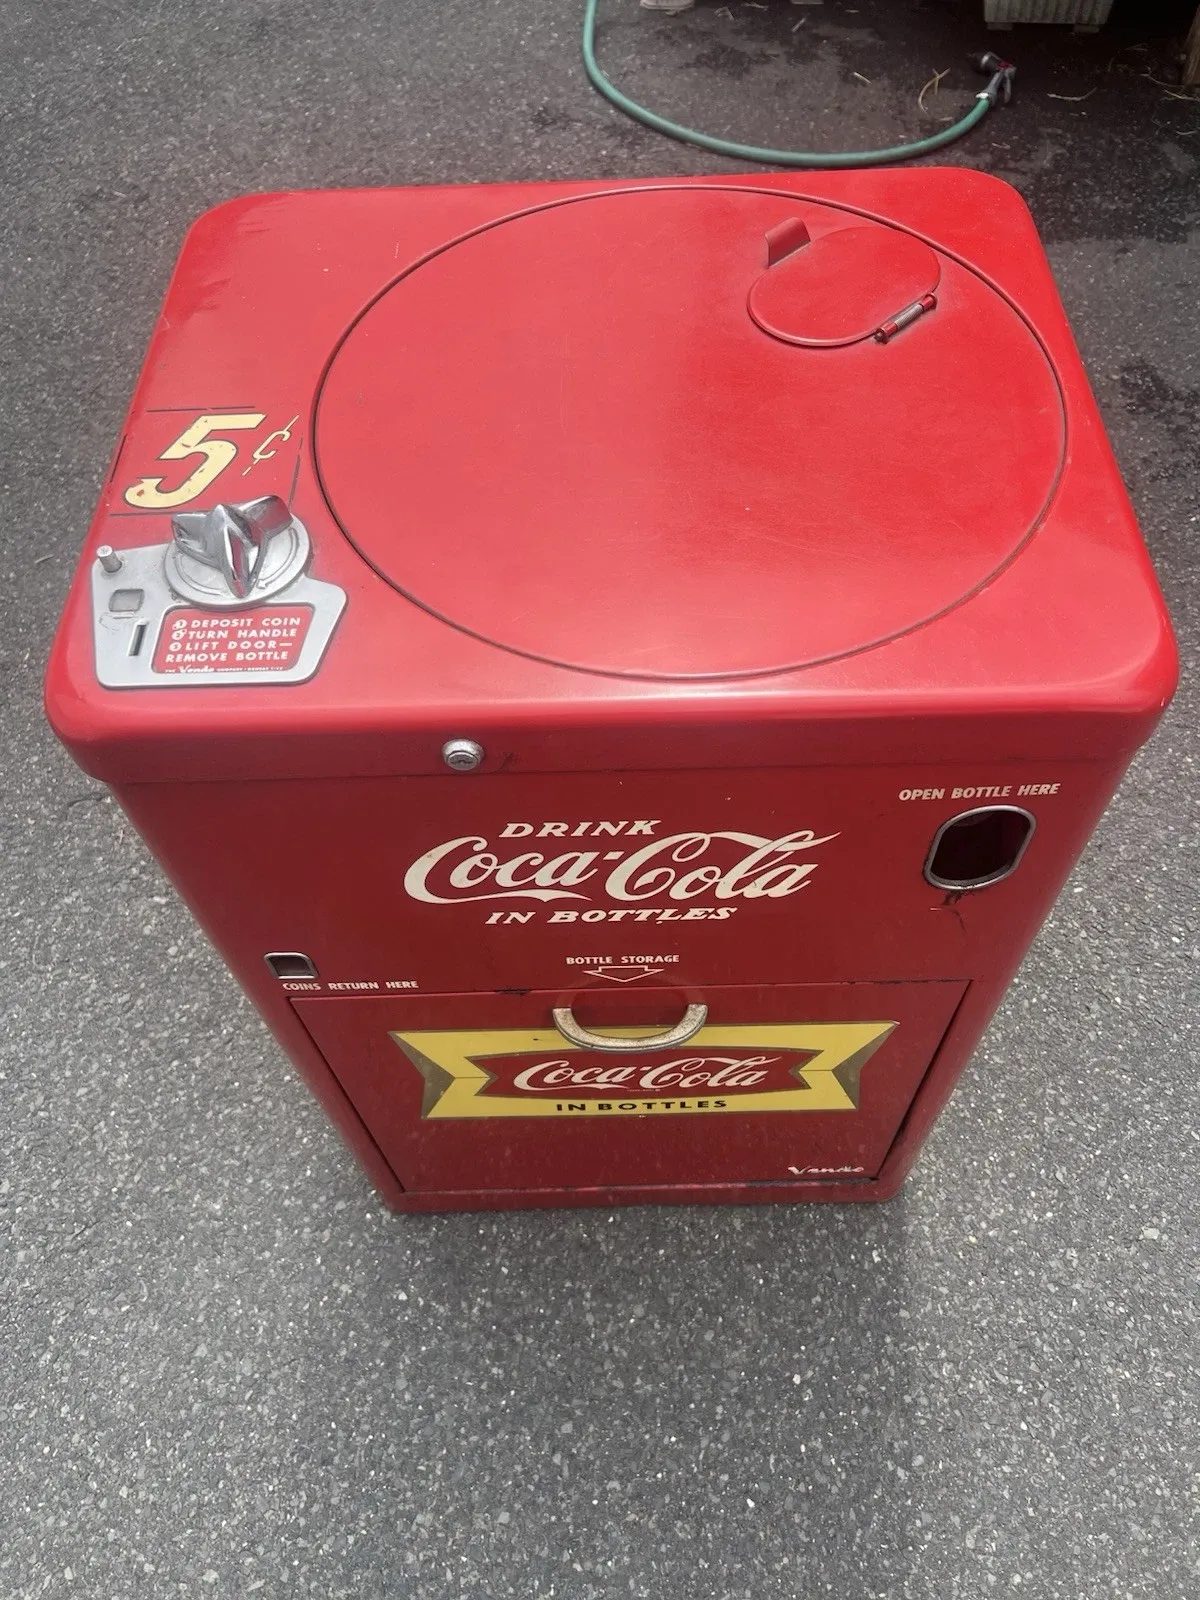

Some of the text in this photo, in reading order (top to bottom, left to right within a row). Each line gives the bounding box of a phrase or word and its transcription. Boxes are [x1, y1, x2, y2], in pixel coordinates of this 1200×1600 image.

[190, 618, 253, 628] DEPOSIT
[261, 617, 301, 627] COIN
[188, 630, 228, 639] TURN
[237, 628, 297, 638] HANDLE
[185, 641, 219, 651] LIFT
[165, 651, 288, 662] REMOVE BOTTLE
[898, 783, 1061, 801] OPEN BOTTLE HERE
[499, 819, 661, 838] DRINK
[403, 829, 841, 903] Coca-Cola
[484, 906, 737, 925] IN BOTTLES
[566, 954, 680, 965] BOTTLE STORAGE
[282, 980, 419, 991] COINS RETURN HERE
[513, 1055, 782, 1092] Coca-Cola
[556, 1100, 727, 1112] IN BOTTLES
